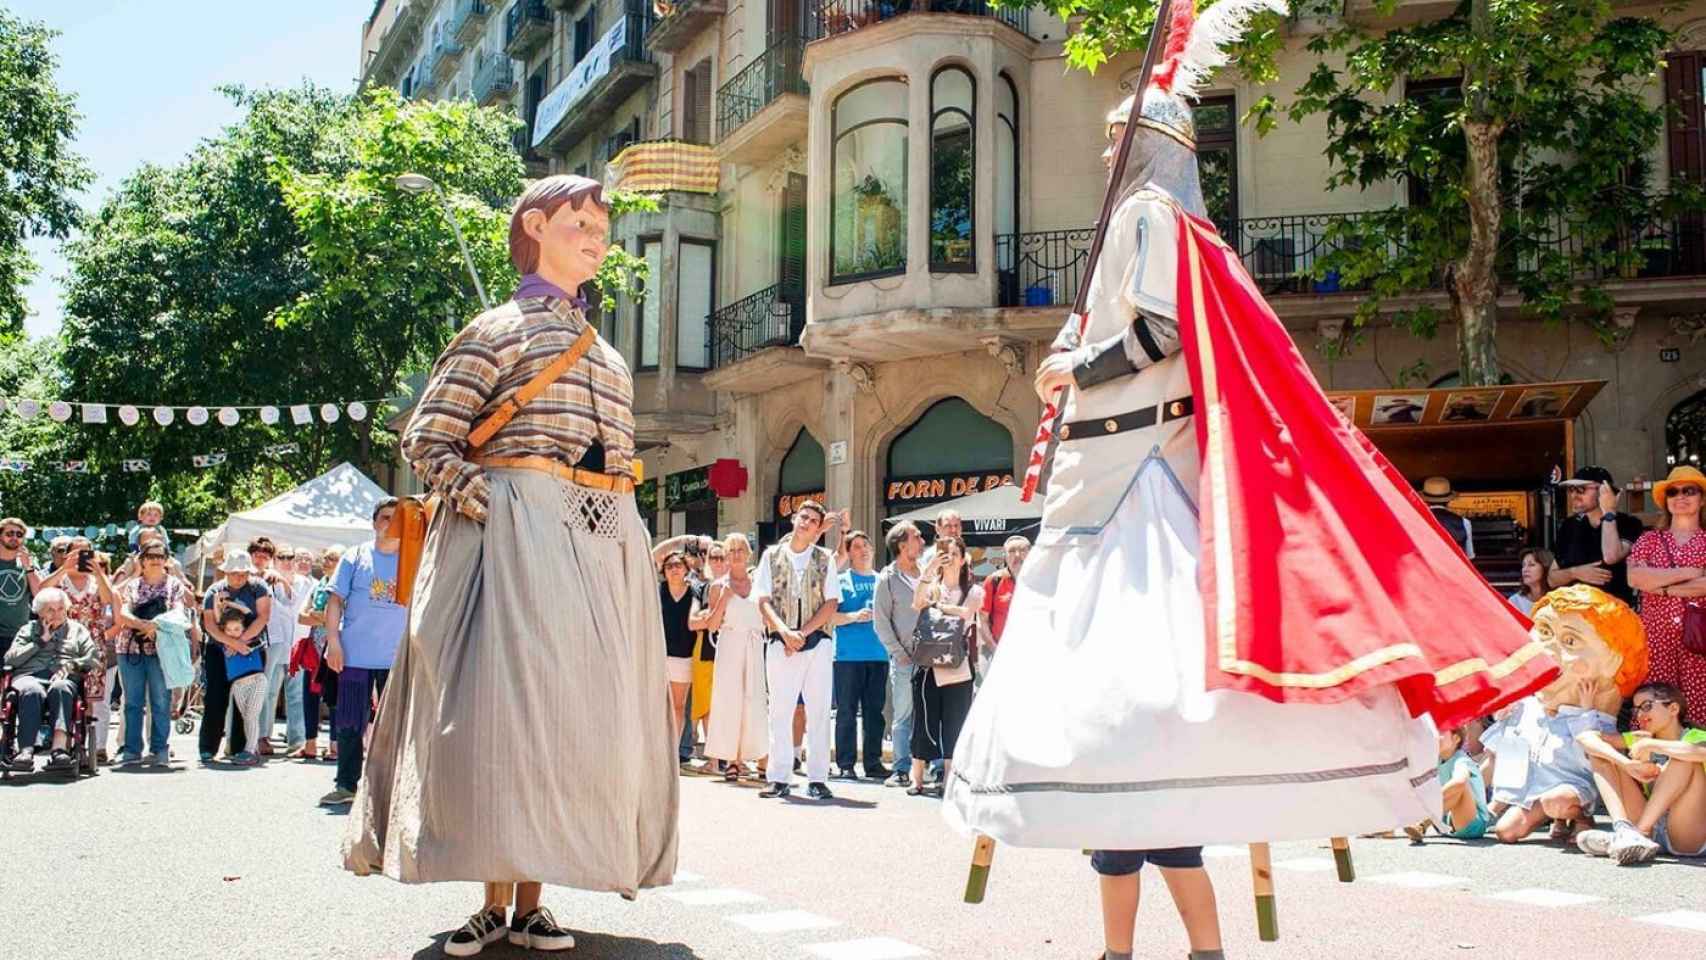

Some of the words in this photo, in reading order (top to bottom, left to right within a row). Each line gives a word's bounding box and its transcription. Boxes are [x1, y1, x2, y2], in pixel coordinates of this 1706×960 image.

[888, 479, 946, 500] FORN
[950, 476, 980, 497] DE
[974, 519, 1006, 531] VIVARI
